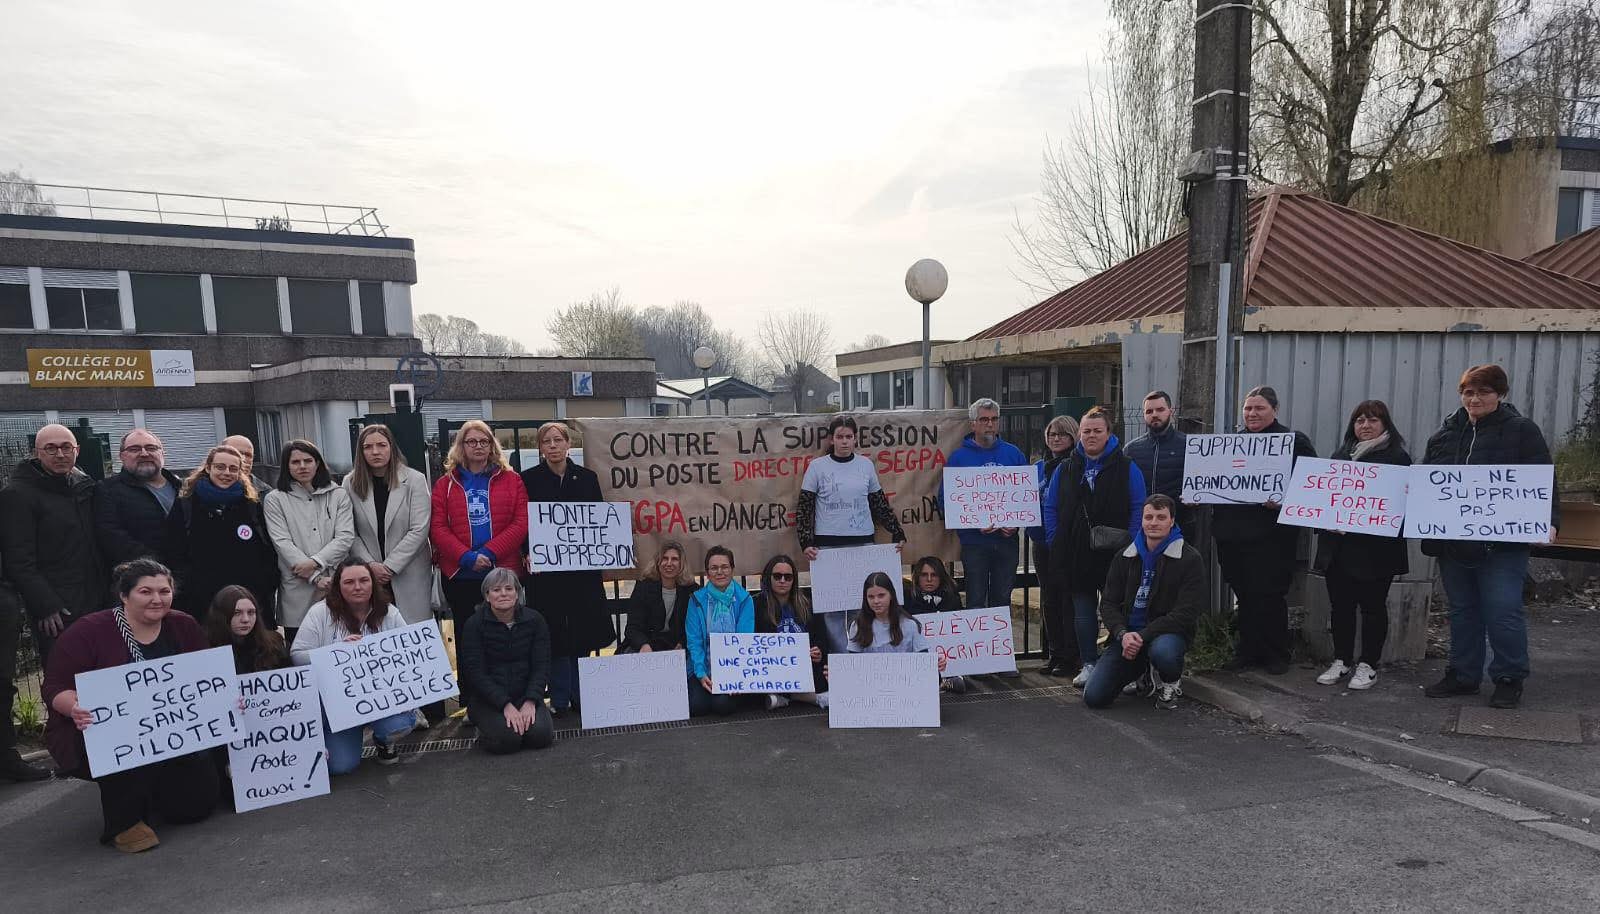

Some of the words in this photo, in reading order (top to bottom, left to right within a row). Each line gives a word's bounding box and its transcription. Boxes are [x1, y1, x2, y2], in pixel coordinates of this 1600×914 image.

[42, 354, 111, 367] COLLÈGE
[115, 356, 137, 367] DU
[35, 370, 86, 381] BLANC
[90, 370, 145, 381] MARAIS
[610, 431, 719, 460] CONTRE
[737, 427, 768, 454] LA
[783, 424, 938, 450] SUPESSION
[1188, 434, 1293, 457] SUPPRIMER
[611, 466, 638, 489] DU
[650, 463, 722, 487] POSTE
[876, 449, 947, 474] SEGPA
[1325, 463, 1379, 479] SANS
[1430, 470, 1462, 485] ON
[1489, 469, 1517, 484] NE
[955, 471, 1032, 488] SUPPRIMER
[1184, 473, 1283, 492] ABANDONNER
[1304, 475, 1365, 491] SEGPA
[950, 492, 965, 502] CE
[972, 490, 1008, 503] POSTE
[1331, 493, 1389, 511] FORTE
[1438, 487, 1549, 501] SUPPRIME
[538, 503, 598, 525] HONTE
[605, 502, 621, 526] À
[630, 499, 688, 534] GPA
[960, 514, 979, 524] DES
[989, 510, 1036, 523] PORTES
[1285, 505, 1324, 518] C'EST
[1460, 503, 1496, 517] PAS
[557, 526, 610, 545] CETTE
[1418, 523, 1446, 535] UN
[1460, 518, 1547, 536] SOUTIEN
[533, 544, 634, 566] SUPPRESSION
[331, 627, 436, 667] DIRECTEUR
[724, 635, 739, 646] LA
[752, 635, 796, 647] SEGPA
[935, 635, 1012, 660] ACRIFIÉS
[718, 658, 740, 666] UNE
[747, 656, 798, 666] CHANCE
[125, 662, 174, 692] PAS
[742, 667, 769, 678] PAS
[239, 670, 312, 696] HAQUE
[719, 681, 744, 691] UNE
[749, 681, 801, 691] CHARGE
[91, 701, 130, 725] DE
[152, 677, 227, 711] SEGPA
[356, 670, 453, 715] OUBLIÉS
[244, 698, 270, 710] lève
[138, 703, 199, 736] SANS
